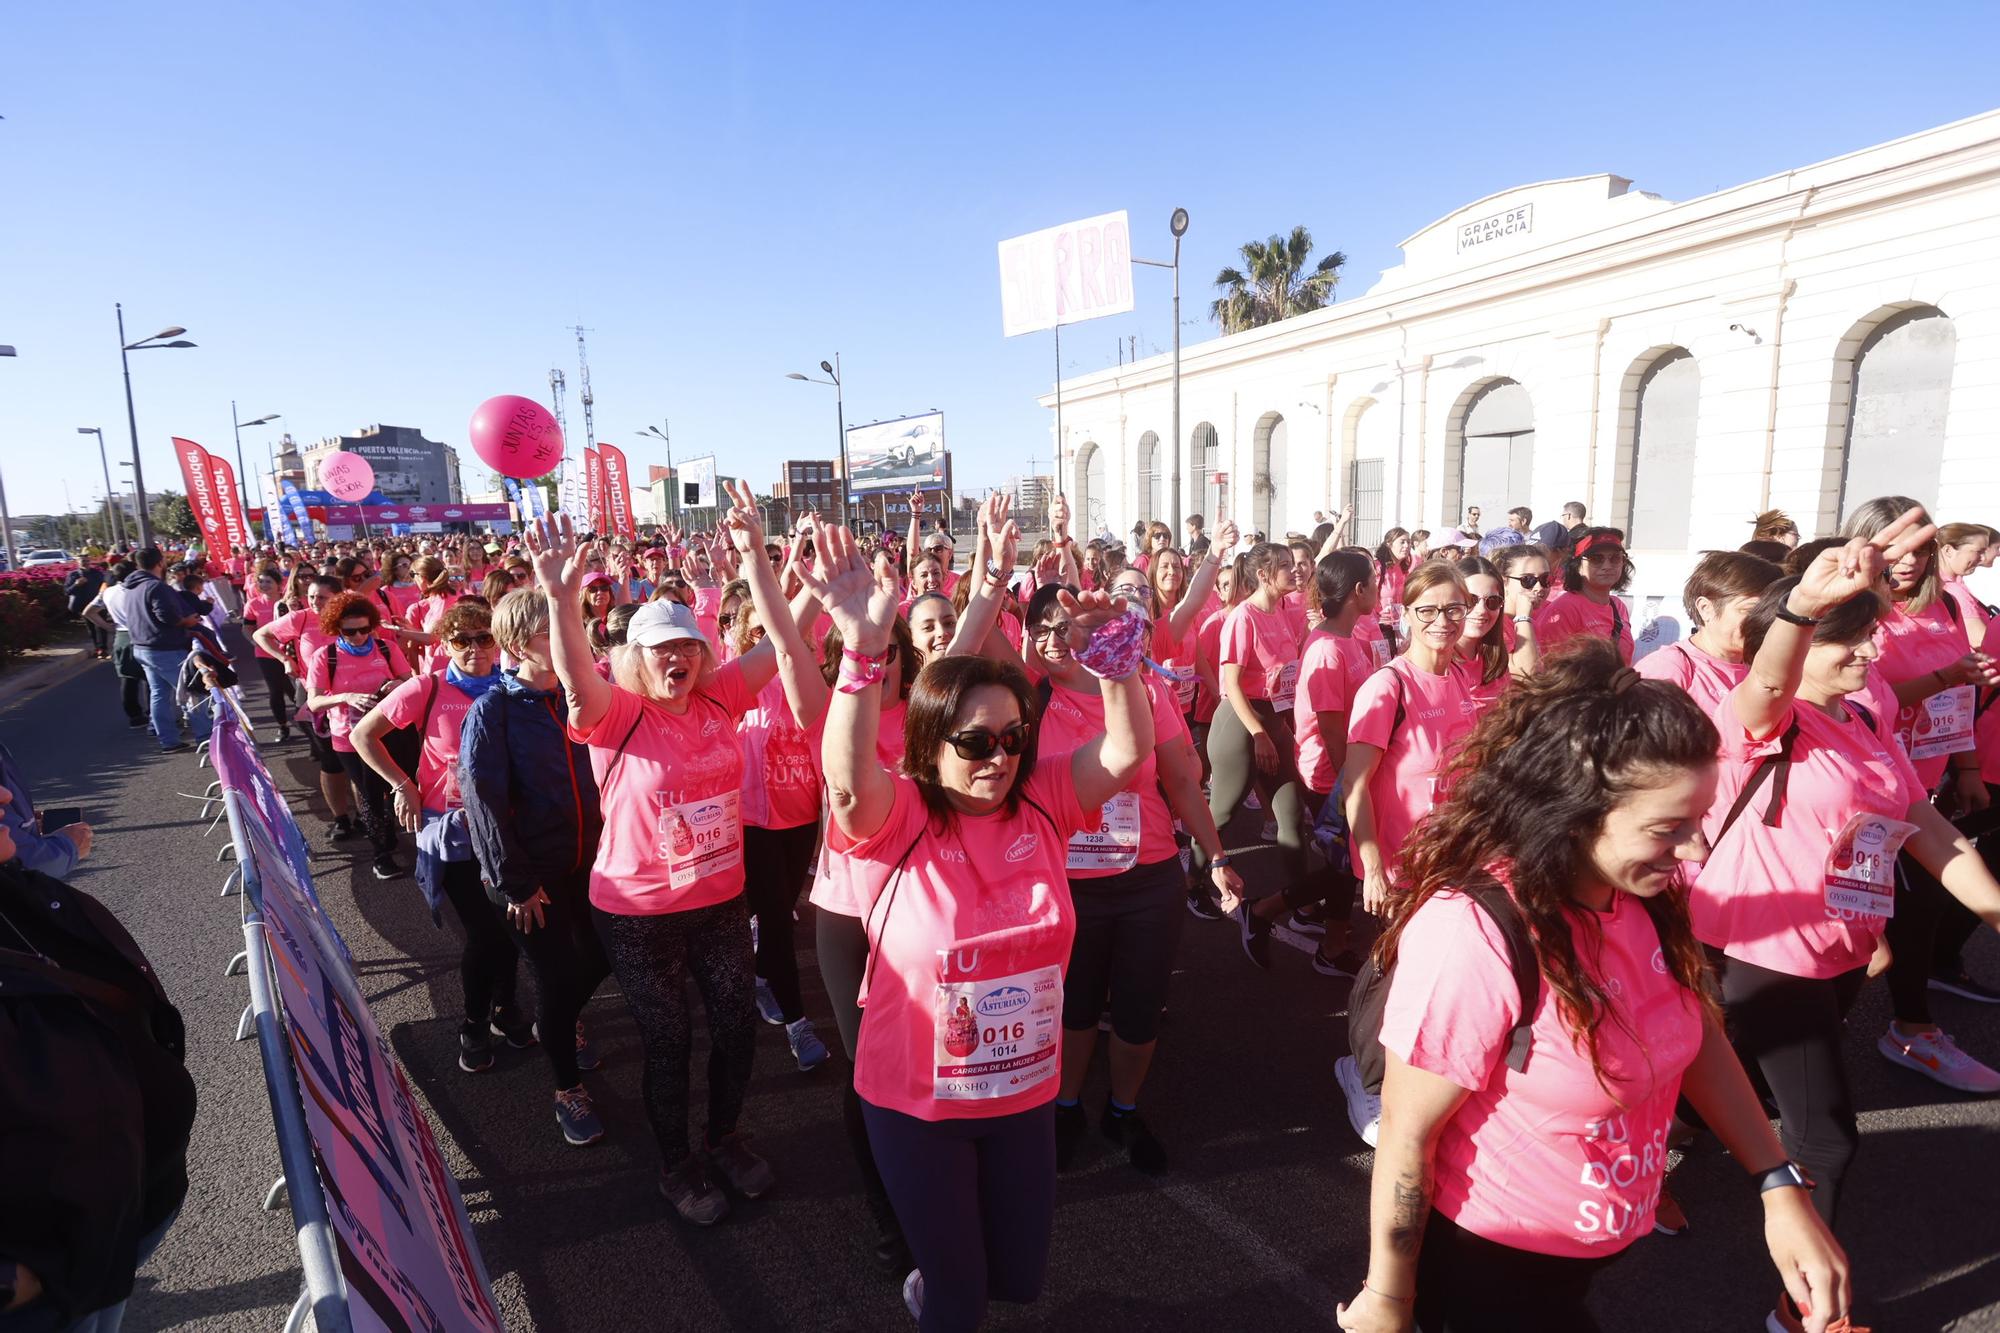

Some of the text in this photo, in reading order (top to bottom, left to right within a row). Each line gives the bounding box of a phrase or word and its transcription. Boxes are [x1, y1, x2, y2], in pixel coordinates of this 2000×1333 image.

[1464, 209, 1526, 237] GRAO DE
[1461, 221, 1527, 248] VALENCIA
[502, 406, 537, 455] JUNTAS
[527, 423, 543, 441] ES
[358, 445, 386, 454] PUERTO
[1933, 714, 1954, 727] 016
[655, 789, 684, 808] TU
[696, 827, 721, 844] 016
[1085, 835, 1104, 844] 1238
[703, 842, 715, 852] 151
[1855, 850, 1880, 868] 016
[1829, 891, 1858, 904] OYSHO
[936, 948, 979, 976] TU
[1033, 982, 1056, 994] SUMA
[980, 995, 1027, 1013] ASTURIANA
[982, 1021, 1025, 1044] 016
[990, 1044, 1018, 1058] 1014
[951, 1065, 988, 1076] CARRERA
[989, 1064, 1001, 1072] DE
[1001, 1062, 1012, 1071] LA
[1012, 1055, 1036, 1068] MUJER
[947, 1064, 1051, 1093] OYSHO Santander
[1584, 1113, 1630, 1144] TU
